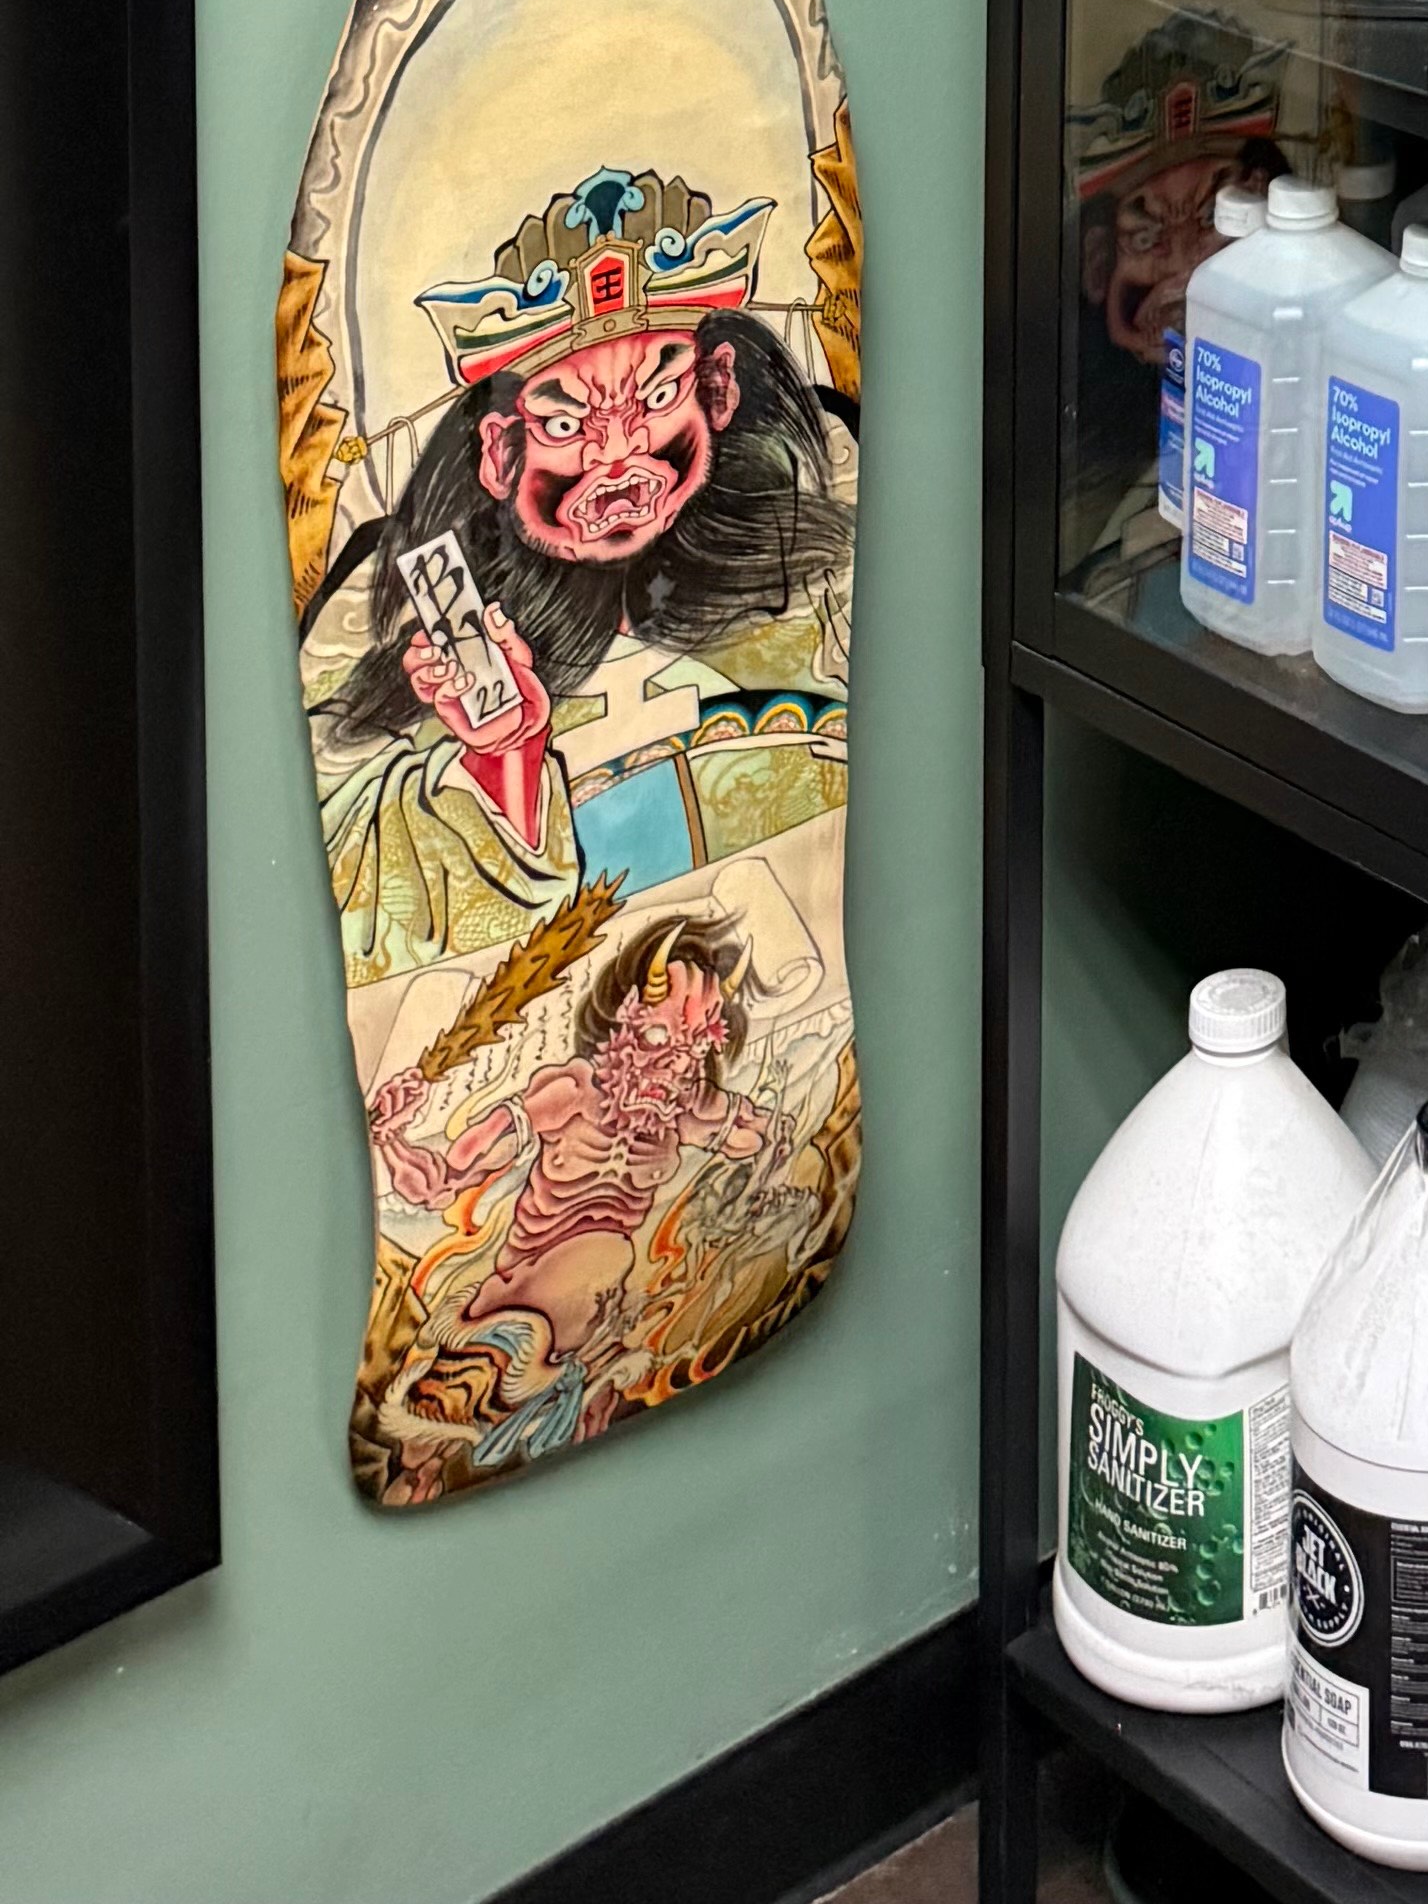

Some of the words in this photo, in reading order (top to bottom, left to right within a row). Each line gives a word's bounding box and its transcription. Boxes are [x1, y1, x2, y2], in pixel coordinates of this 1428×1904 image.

[591, 266, 624, 305] 王
[1197, 346, 1222, 373] 70%
[1195, 364, 1252, 405] Isopropyl
[1196, 385, 1240, 419] Alcohol
[1332, 385, 1359, 413] 70%
[1331, 404, 1392, 446] Isopropyl
[1331, 425, 1379, 460] Alcohol
[476, 679, 518, 722] 22
[1091, 1383, 1145, 1436] FROGGY'S
[1089, 1402, 1204, 1490] SIMPLY
[1087, 1440, 1205, 1517] SANITIZER
[1123, 1519, 1188, 1551] SANITIZER
[1302, 1523, 1326, 1568] JET
[1324, 1687, 1352, 1715] SOAP
